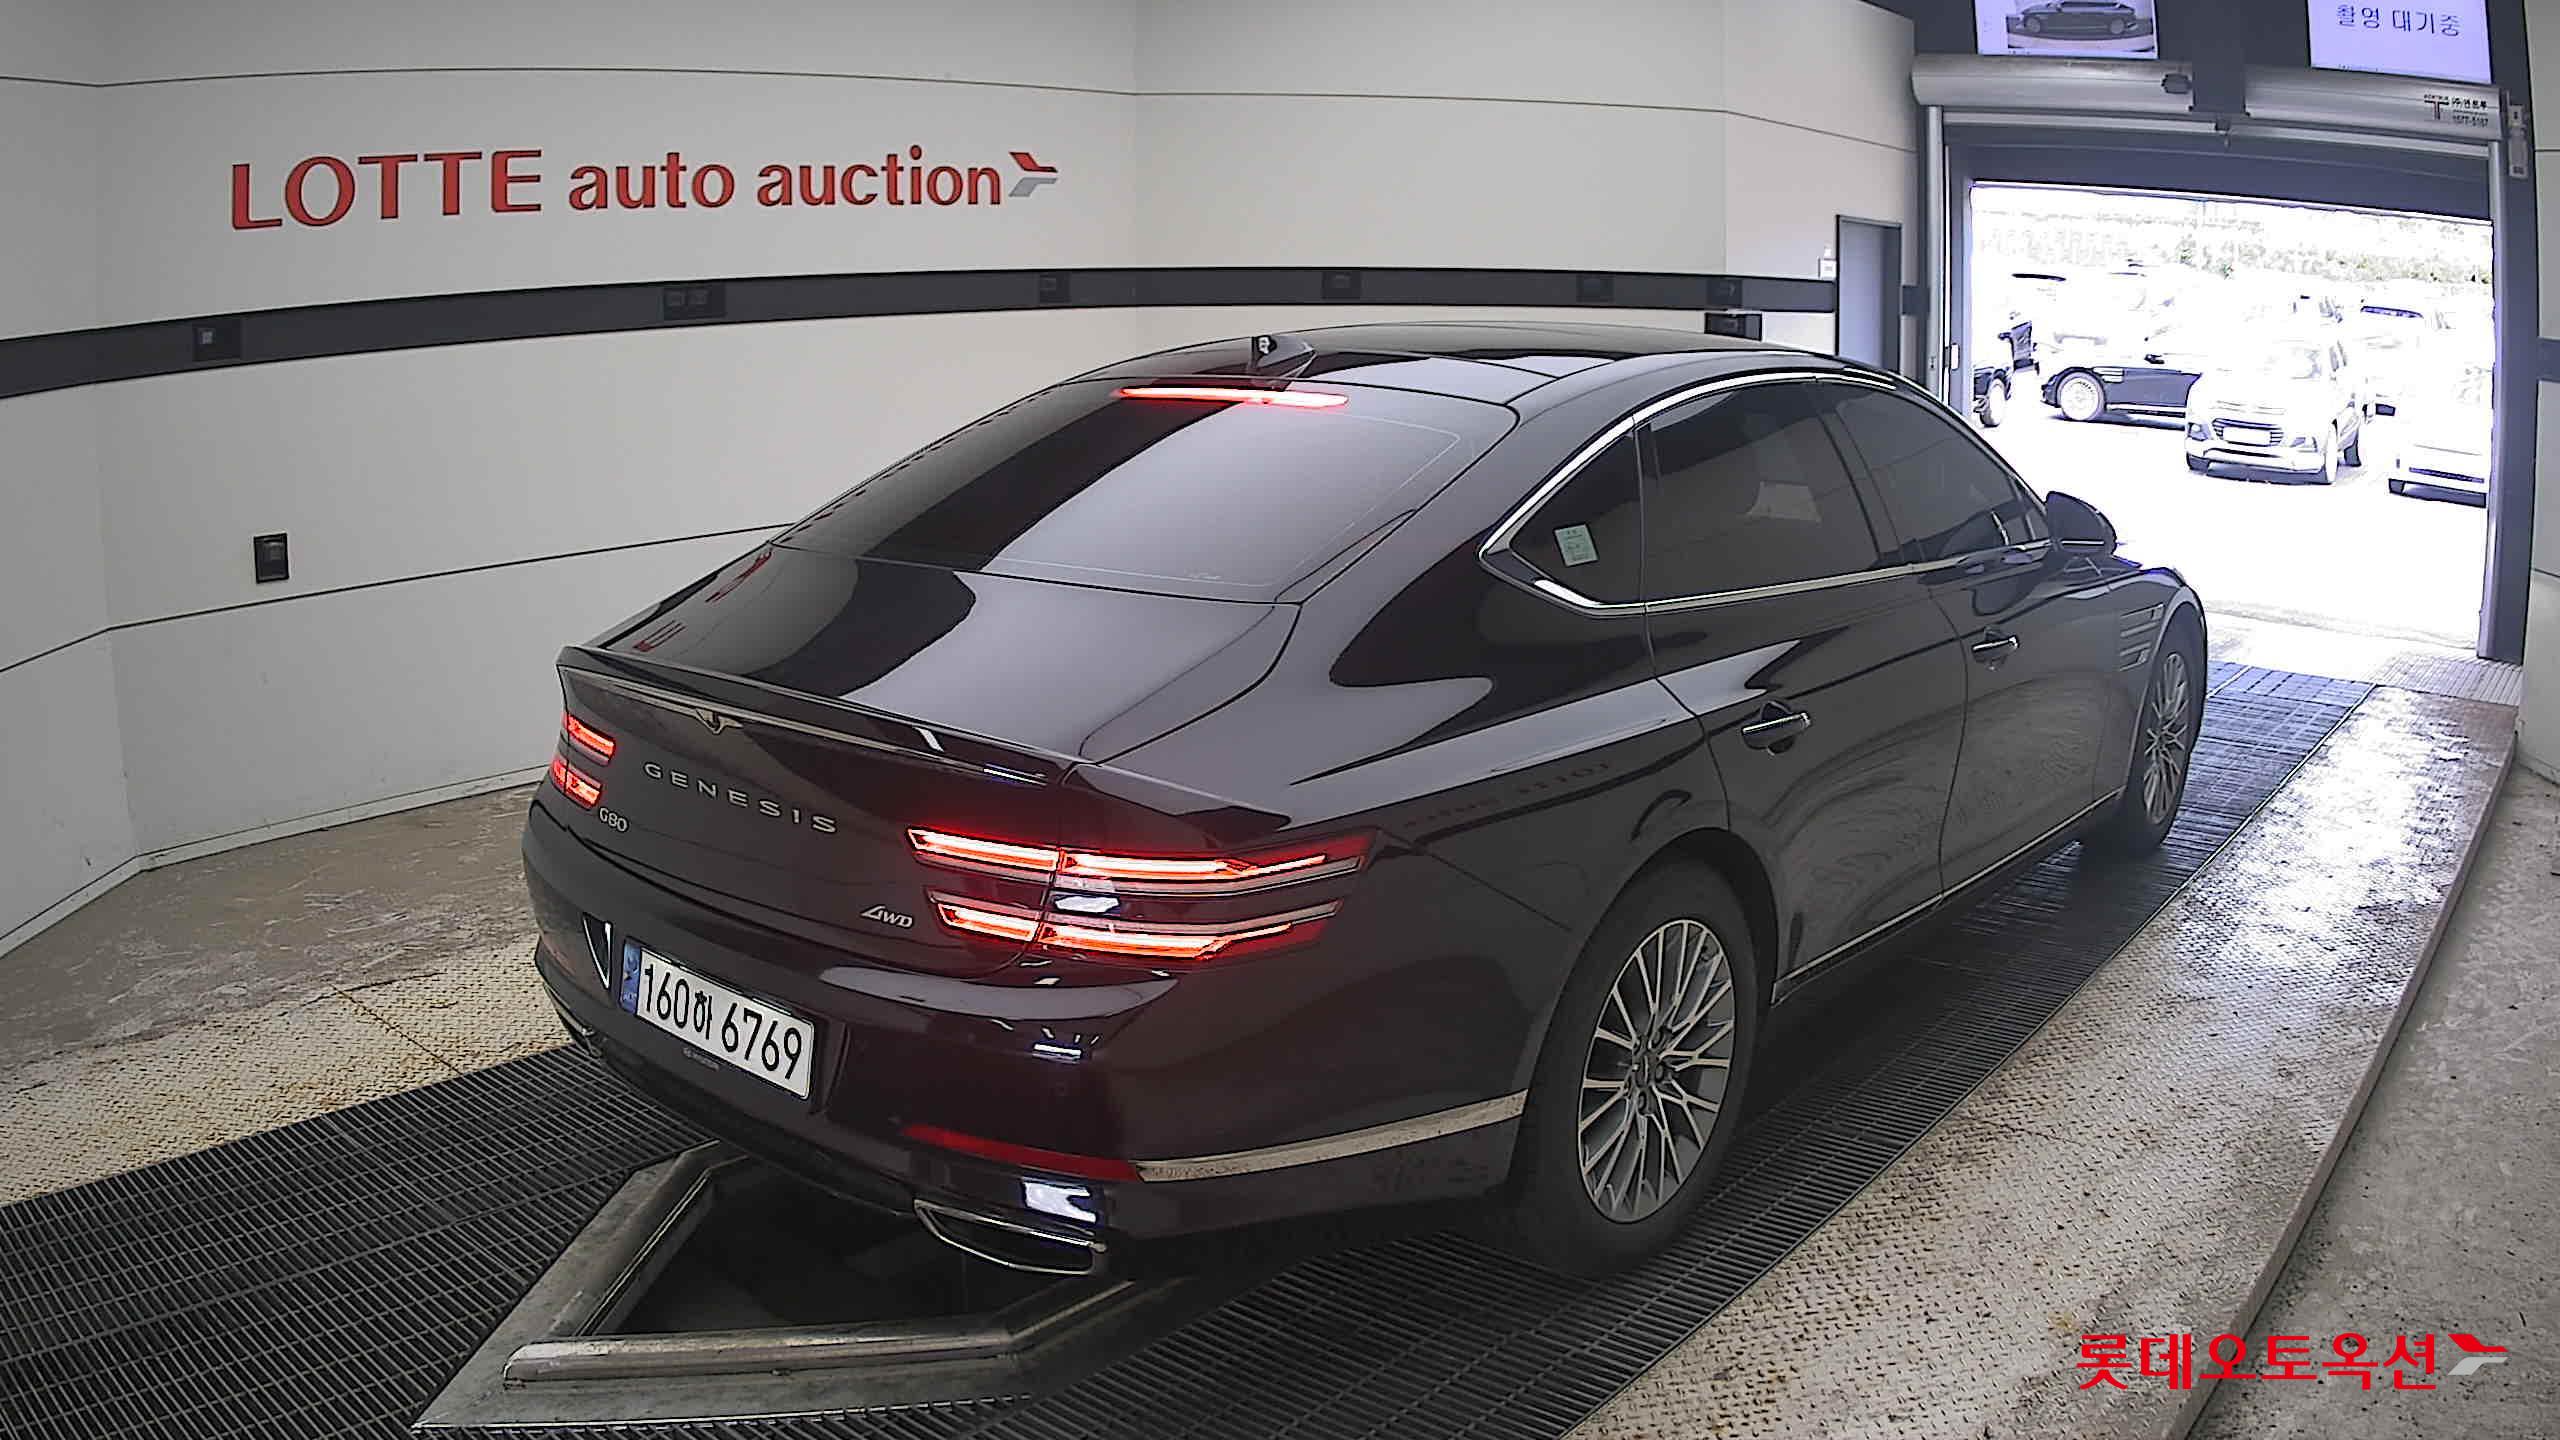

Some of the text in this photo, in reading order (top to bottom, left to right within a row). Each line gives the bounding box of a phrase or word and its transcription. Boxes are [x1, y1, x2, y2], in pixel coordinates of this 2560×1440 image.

[2336, 5, 2461, 37] 촬영 대기중
[231, 145, 1002, 230] LOTTE auto auction
[599, 806, 629, 833] G80
[643, 761, 837, 834] GENESIS
[859, 905, 915, 929] 4WD
[643, 963, 802, 1080] 160하 6769
